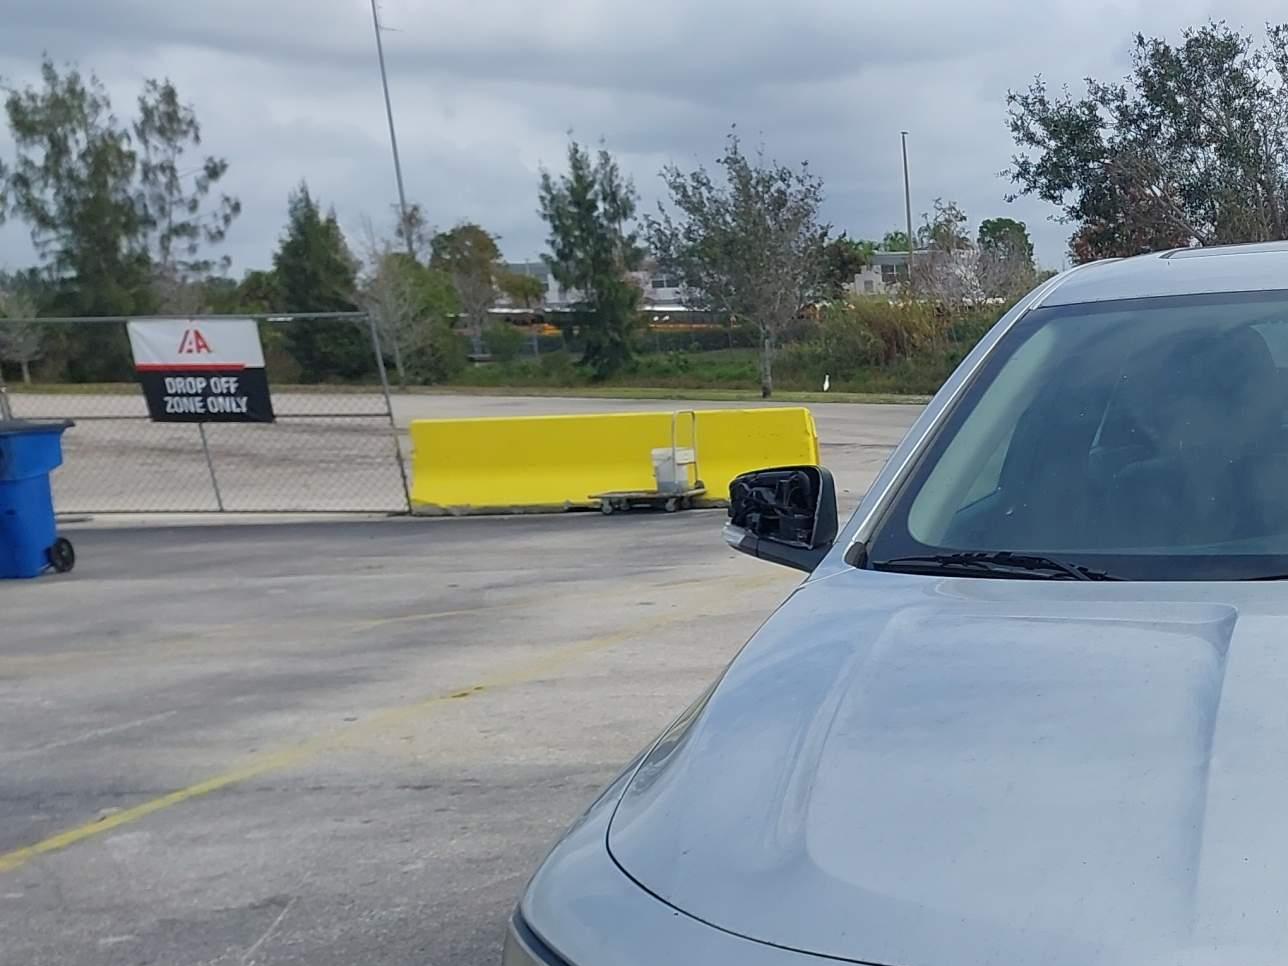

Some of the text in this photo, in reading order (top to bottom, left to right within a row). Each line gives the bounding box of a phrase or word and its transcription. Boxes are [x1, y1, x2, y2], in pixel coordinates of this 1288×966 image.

[164, 377, 240, 394] DROP OFF
[163, 396, 248, 414] ZONE ONLY
